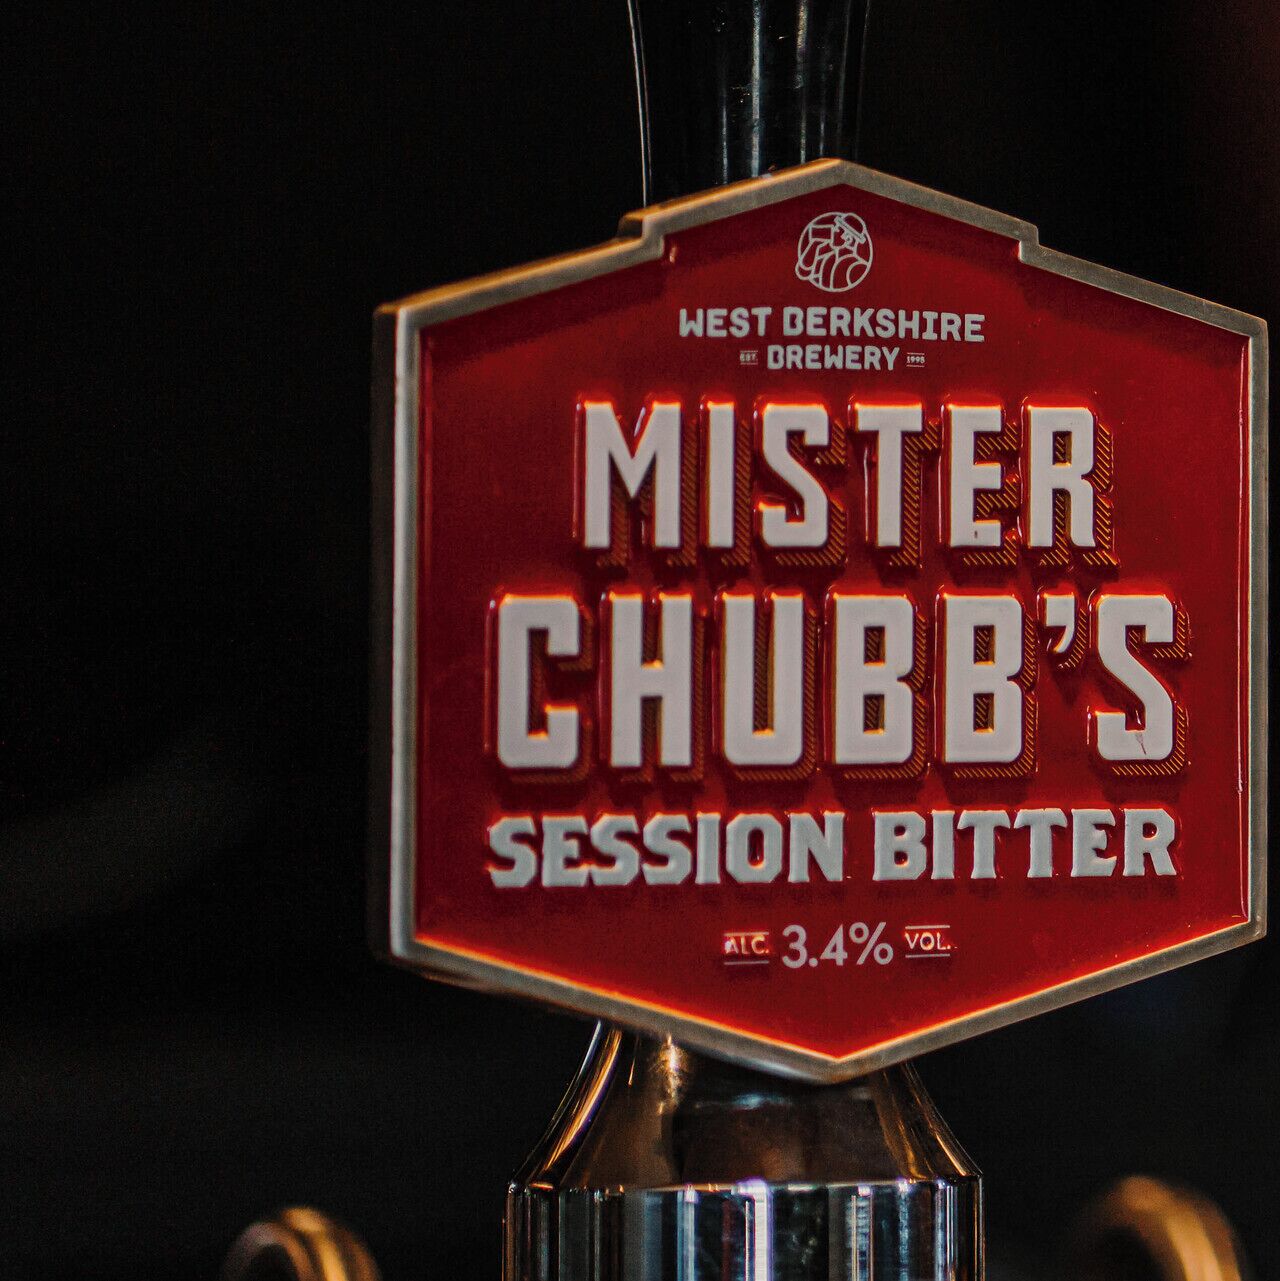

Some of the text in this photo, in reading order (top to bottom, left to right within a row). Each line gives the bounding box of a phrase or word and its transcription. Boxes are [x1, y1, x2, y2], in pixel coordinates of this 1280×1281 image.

[679, 306, 986, 342] WEST BERKSHIRE
[767, 344, 900, 370] BREWERY
[581, 401, 1097, 550] MISTER
[496, 592, 1176, 769] CHUBB'S
[487, 806, 1178, 888] SESSION BITTER
[781, 921, 894, 969] 3.4%
